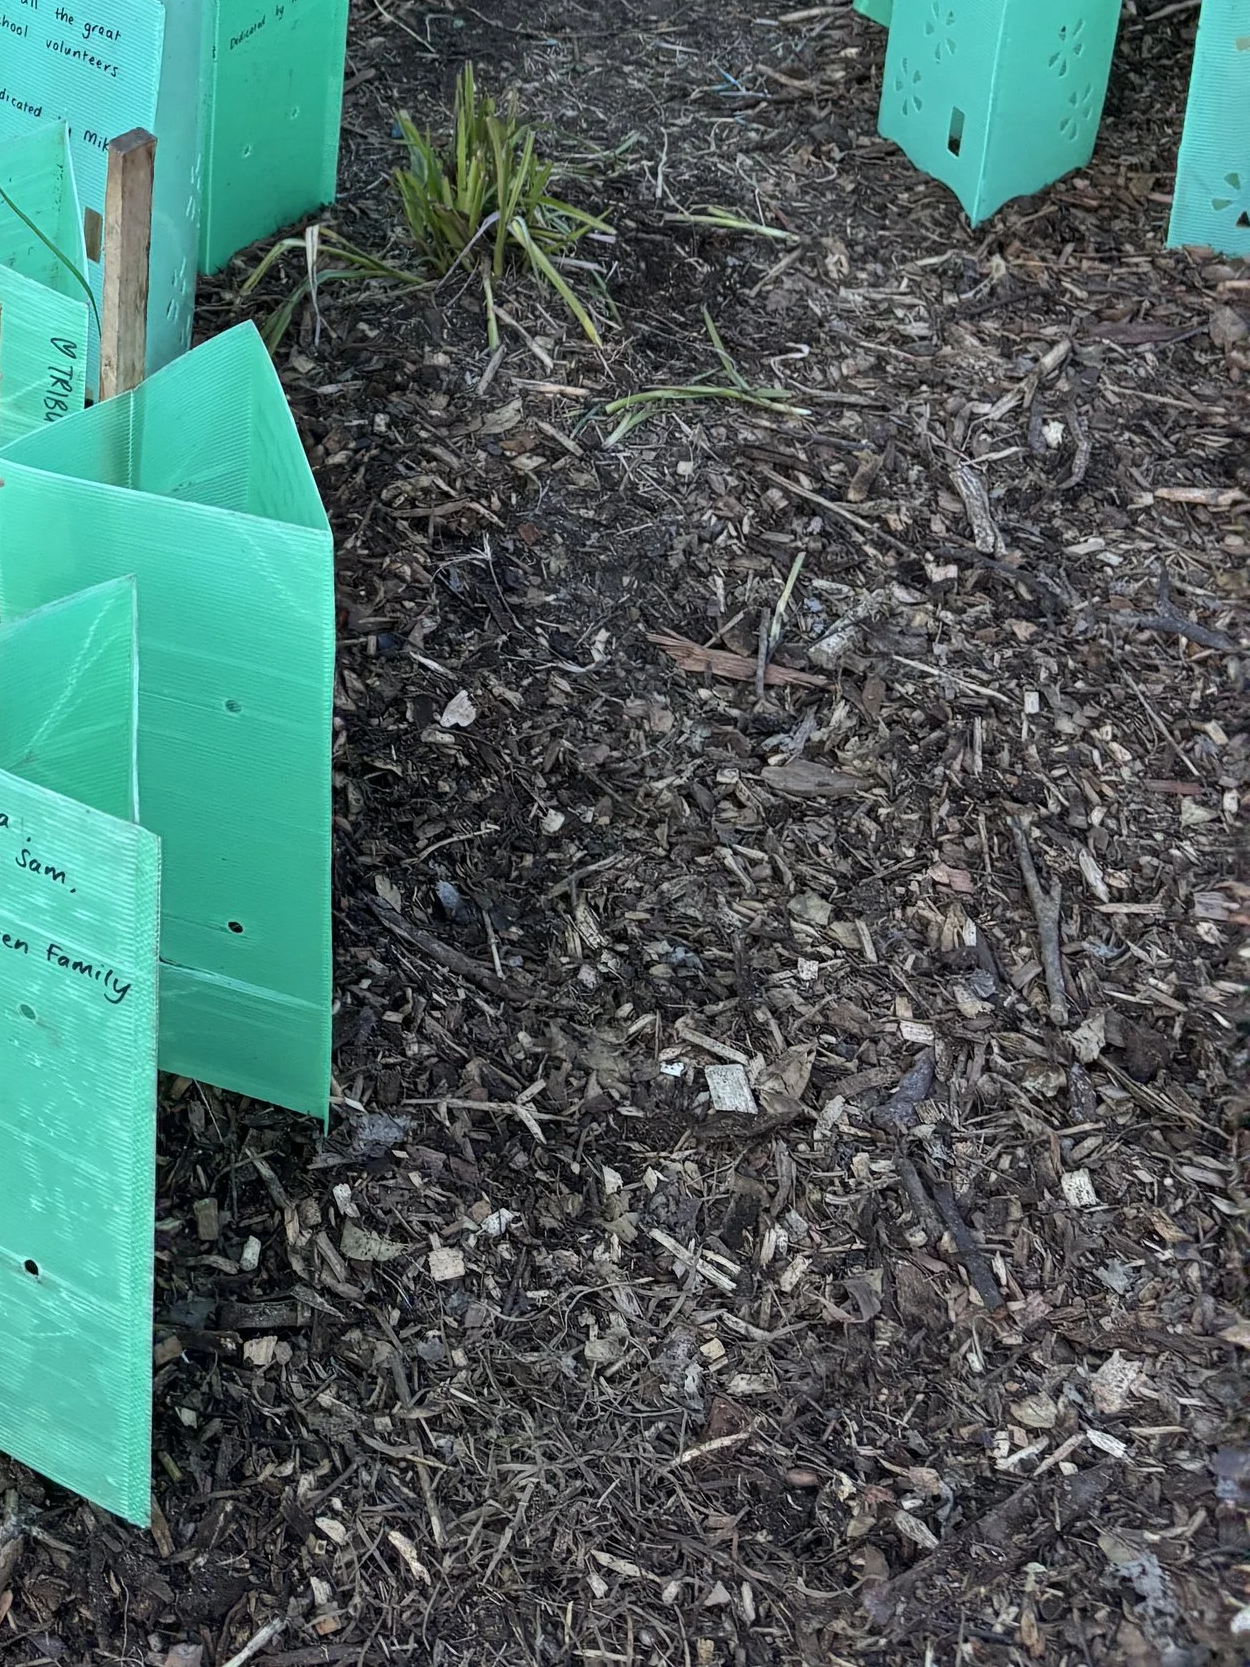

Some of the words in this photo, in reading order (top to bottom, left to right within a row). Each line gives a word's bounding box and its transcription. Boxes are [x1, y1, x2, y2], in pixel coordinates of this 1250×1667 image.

[55, 7, 74, 25] the
[82, 22, 122, 41] great
[230, 16, 266, 50] Dedicated
[275, 5, 285, 21] by
[46, 39, 119, 77] volunteers
[44, 365, 74, 423] TRIBU
[46, 943, 132, 1004] Family
